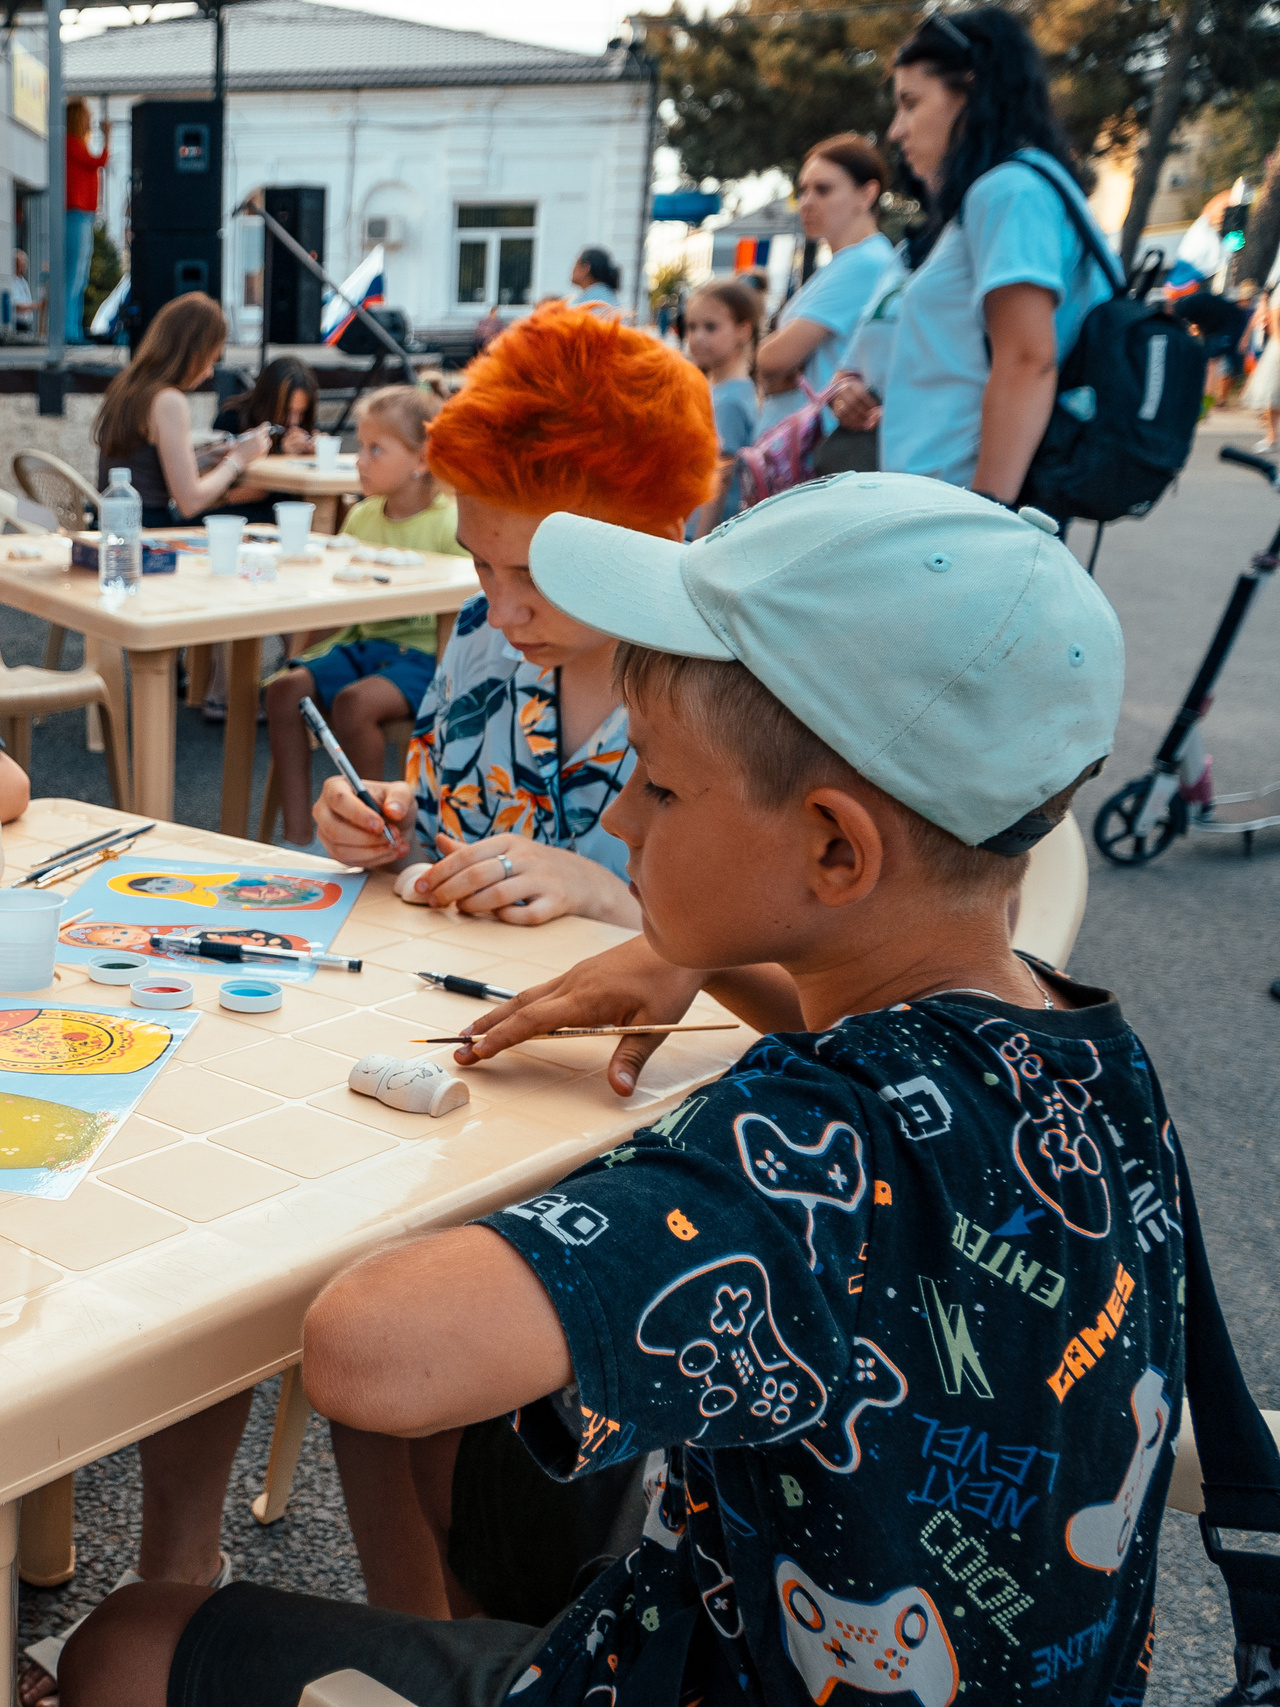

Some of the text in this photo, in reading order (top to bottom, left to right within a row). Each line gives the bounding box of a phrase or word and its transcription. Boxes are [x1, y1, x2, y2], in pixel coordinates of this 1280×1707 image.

[951, 1211, 1066, 1309] ENTER
[1046, 1262, 1136, 1404] GAMES
[906, 1465, 1039, 1530] NEXT
[913, 1413, 1060, 1494] LEVEL
[920, 1510, 1035, 1646] COOL
